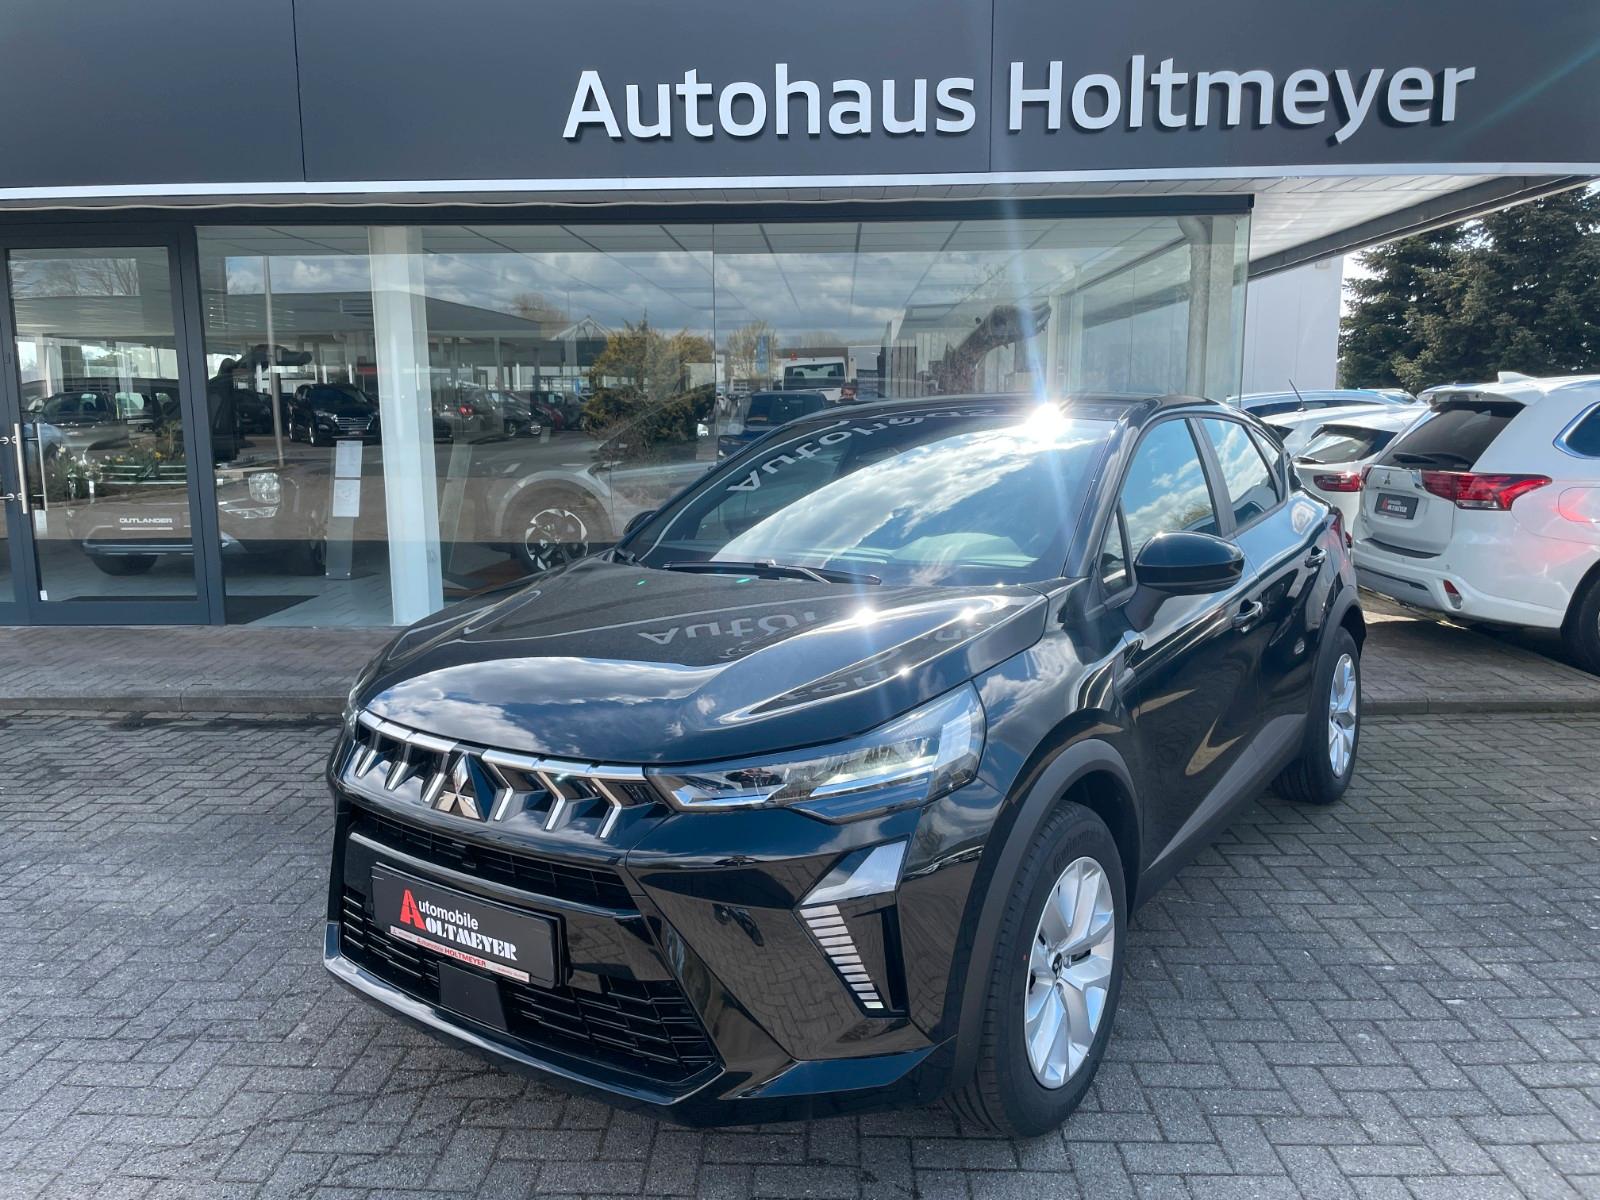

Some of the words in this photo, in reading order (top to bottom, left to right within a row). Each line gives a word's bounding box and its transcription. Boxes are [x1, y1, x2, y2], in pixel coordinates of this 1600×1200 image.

[562, 63, 976, 138] Autohaus
[1008, 54, 1477, 144] Holtmeyer
[400, 888, 479, 932] Automobile
[444, 947, 487, 967] HOLTMEYER
